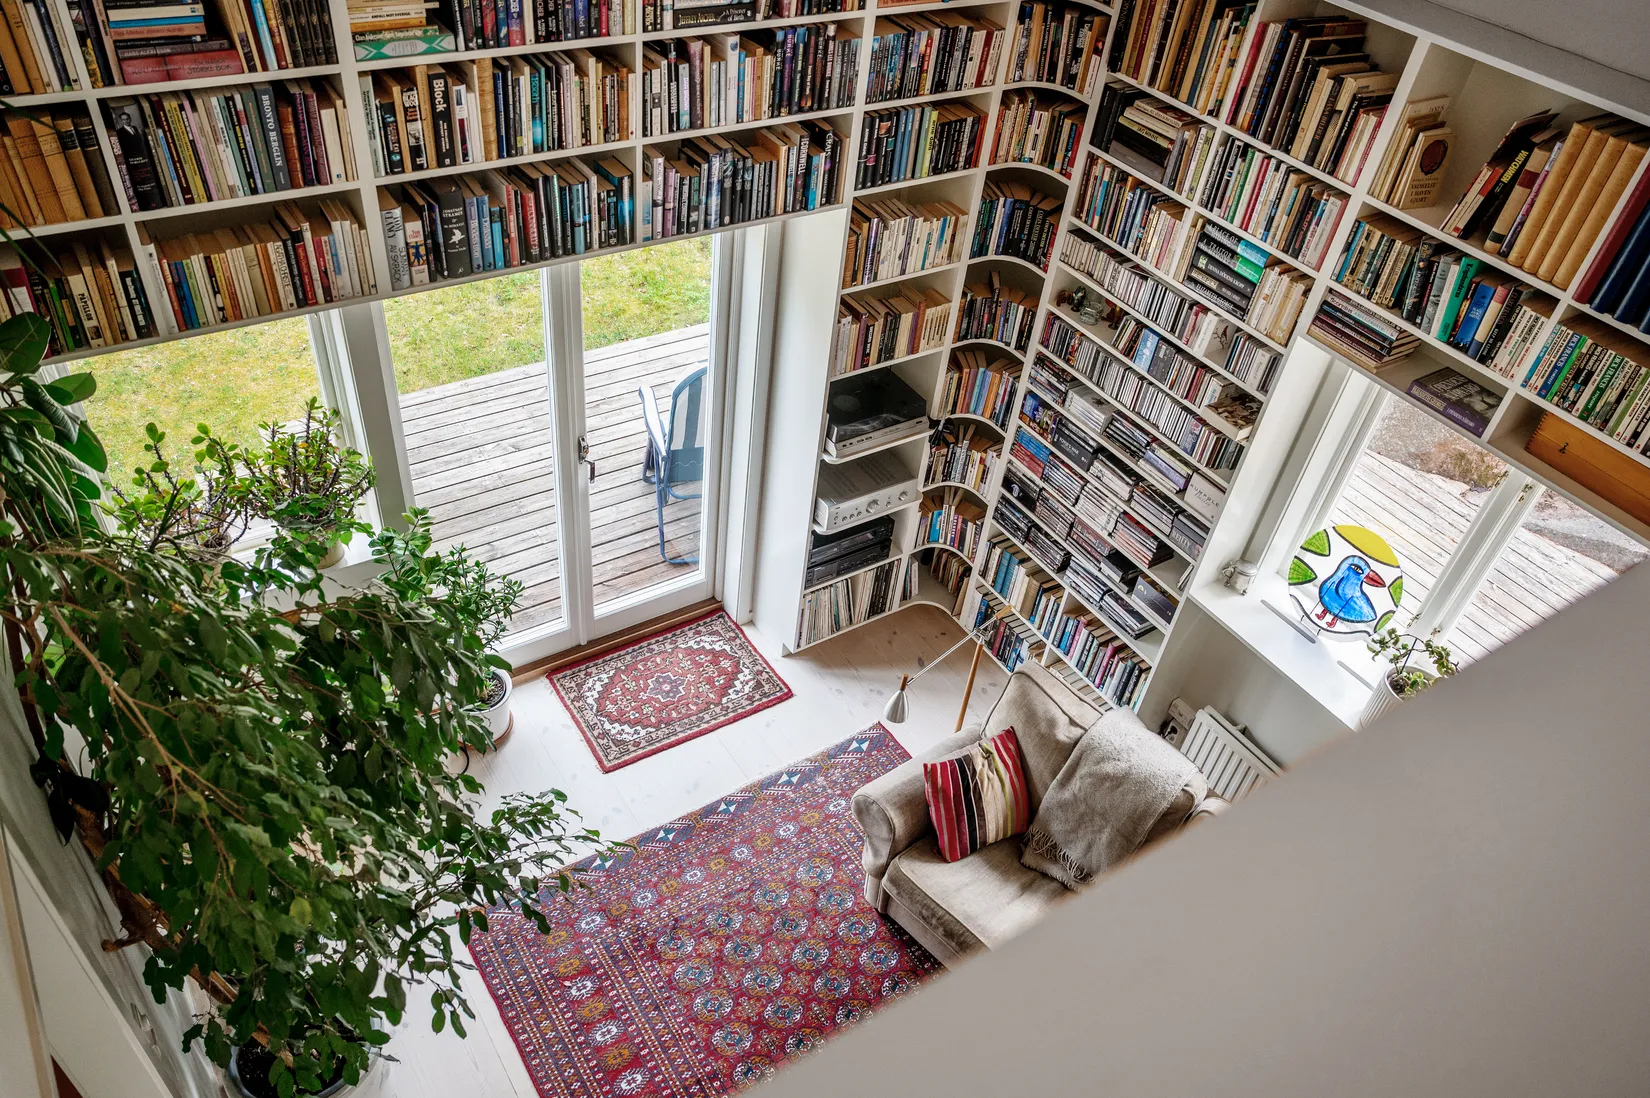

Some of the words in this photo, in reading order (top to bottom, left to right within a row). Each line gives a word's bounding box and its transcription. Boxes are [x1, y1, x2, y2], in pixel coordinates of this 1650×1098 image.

[433, 78, 446, 112] Block
[260, 94, 275, 129] BRONTO
[268, 130, 283, 167] BERGLIN
[1499, 149, 1528, 183] WATCHMEN
[78, 292, 93, 321] PAPILLON
[1567, 333, 1579, 347] DICK
[1555, 345, 1572, 368] FRANCIS
[1610, 354, 1622, 368] DICK
[1597, 366, 1614, 388] FRANCIS
